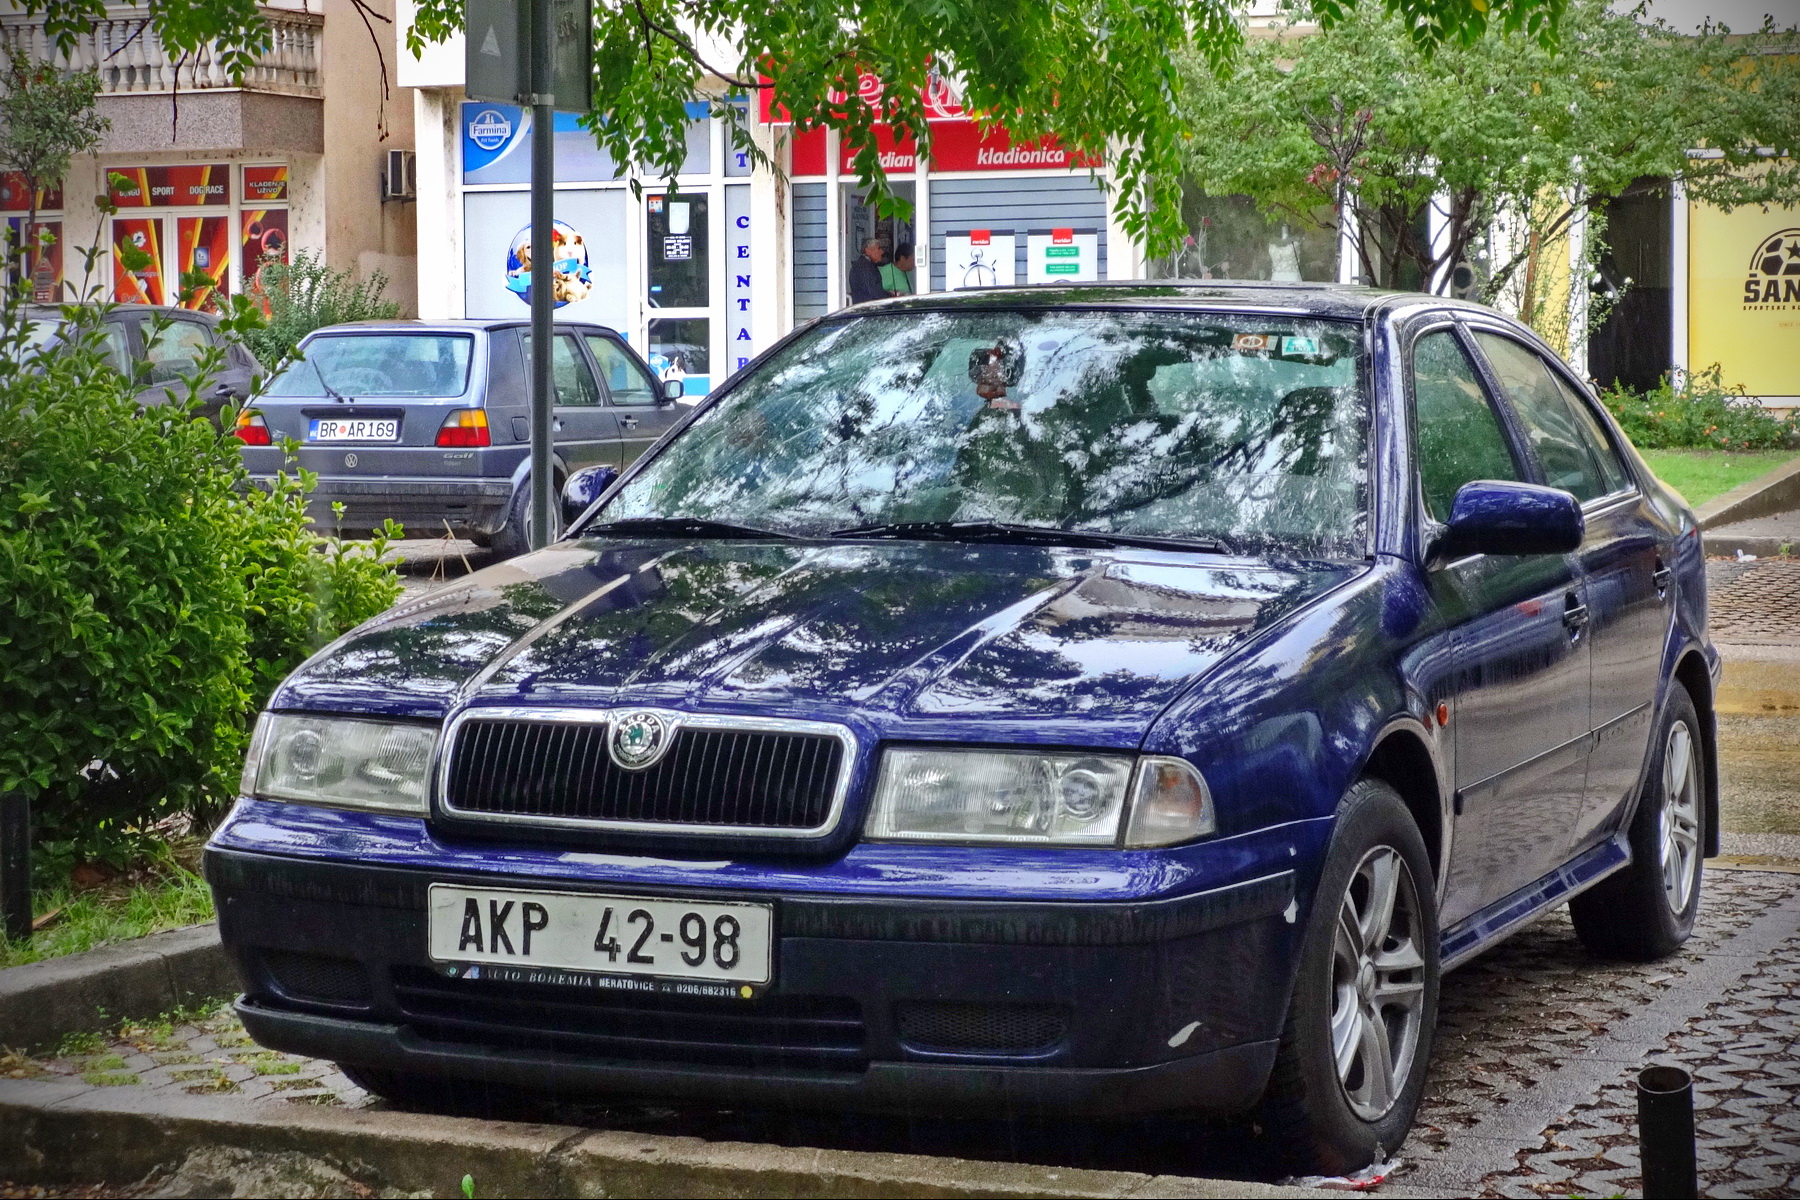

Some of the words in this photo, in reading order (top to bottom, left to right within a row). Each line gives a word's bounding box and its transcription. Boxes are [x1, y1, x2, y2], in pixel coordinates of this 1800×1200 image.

[473, 125, 507, 135] Farmina
[977, 147, 1065, 165] kladionica
[152, 186, 175, 196] SPORT
[189, 186, 204, 195] DOG
[205, 185, 224, 194] RACE
[320, 422, 338, 438] BR
[347, 422, 395, 438] AR169
[459, 897, 549, 956] AKP
[594, 907, 741, 970] 42-98
[528, 971, 592, 987] BOHEMIA
[599, 978, 654, 991] NERATOVICE
